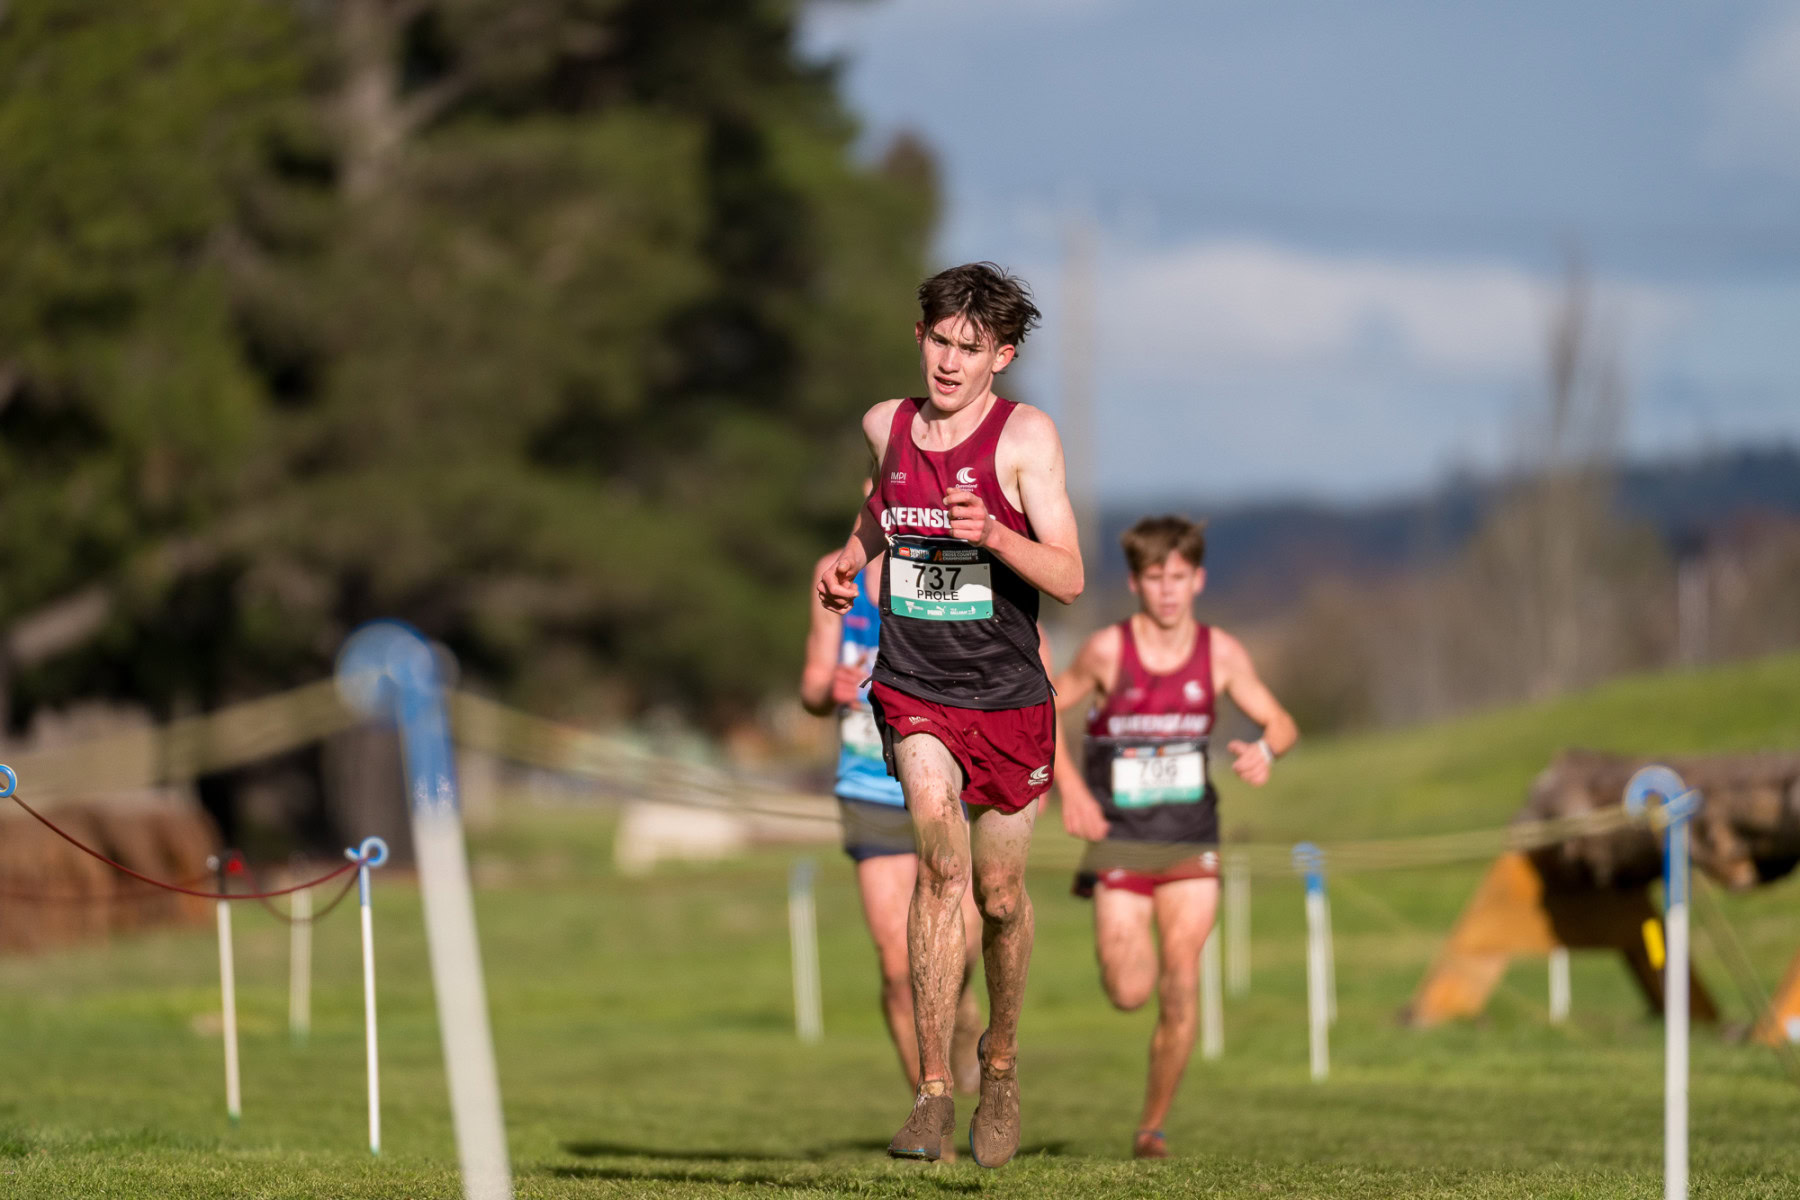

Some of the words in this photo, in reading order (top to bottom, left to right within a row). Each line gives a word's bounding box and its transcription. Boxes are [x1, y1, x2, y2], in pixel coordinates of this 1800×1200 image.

[890, 472, 906, 480] IMPI
[912, 564, 961, 590] 737
[917, 589, 959, 601] PROLE
